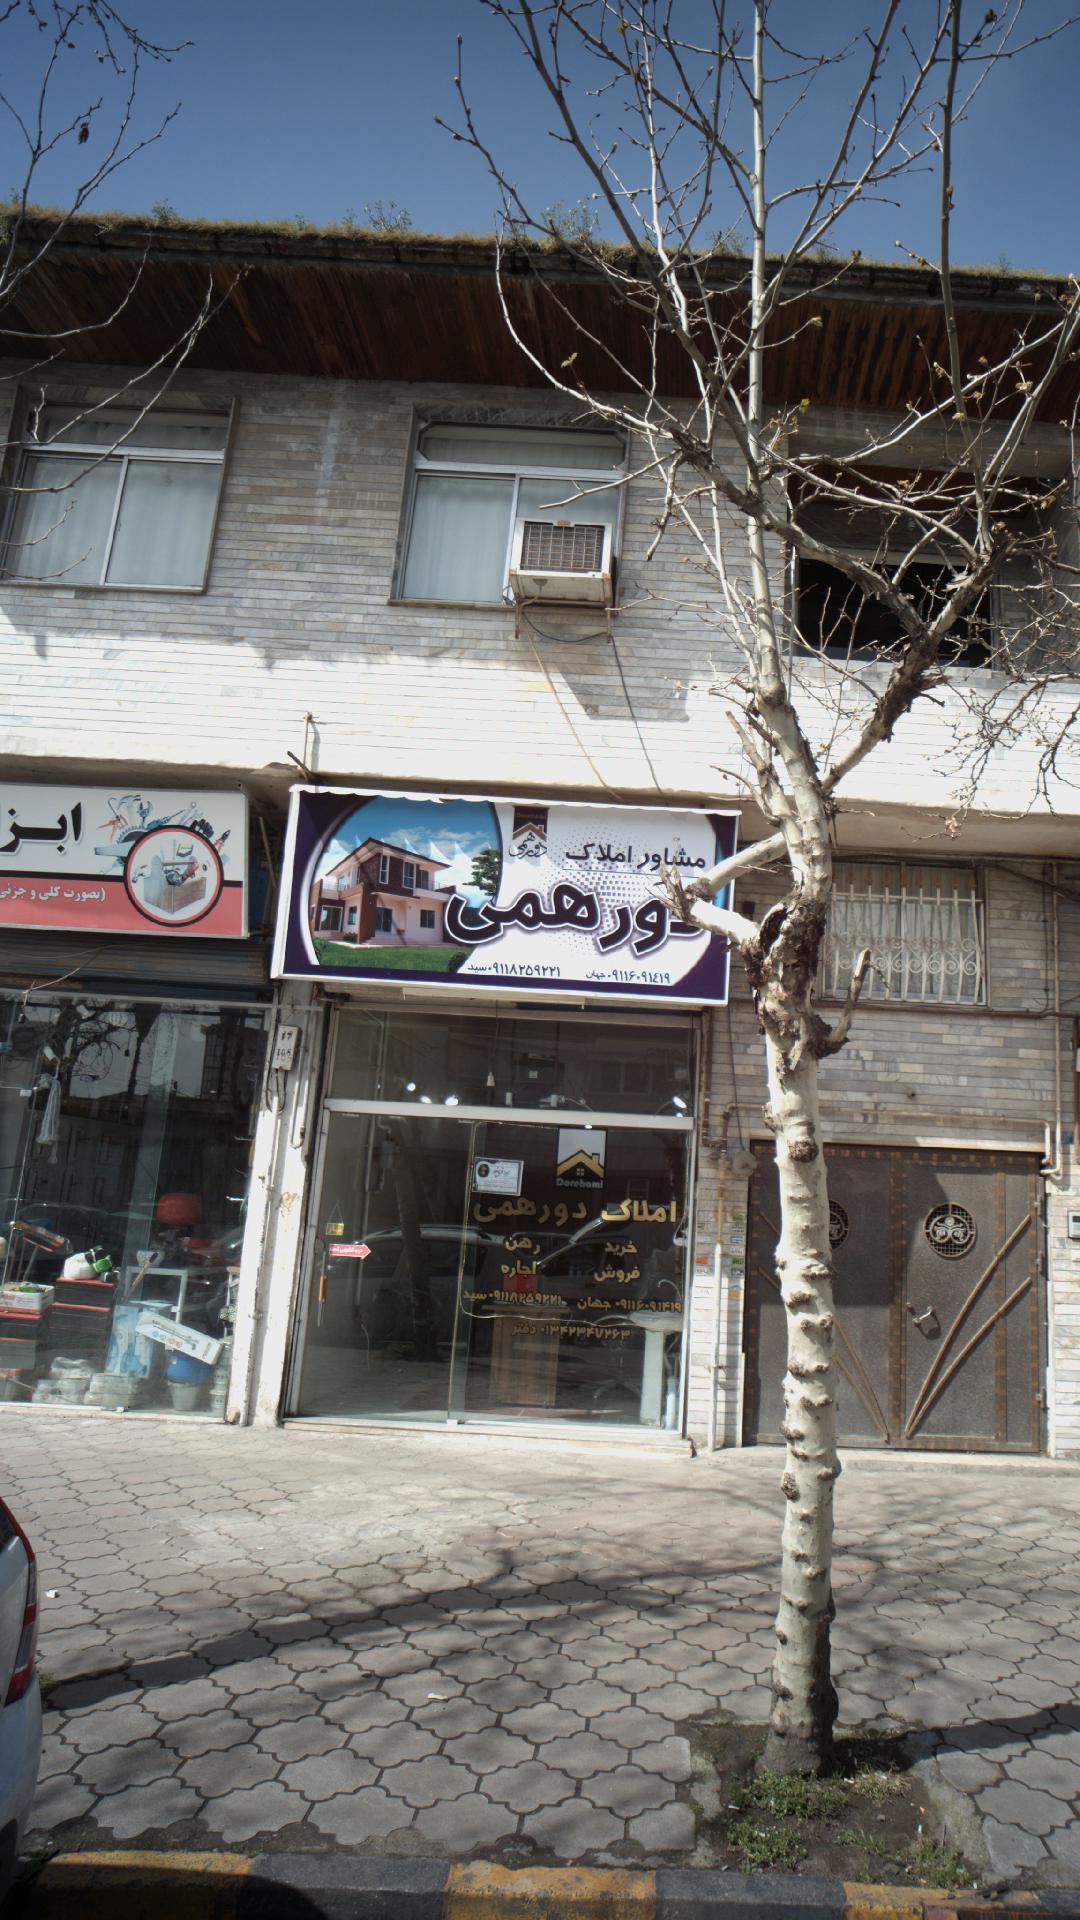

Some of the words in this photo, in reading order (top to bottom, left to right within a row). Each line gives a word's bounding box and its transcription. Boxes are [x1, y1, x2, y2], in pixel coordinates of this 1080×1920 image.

[565, 843, 632, 863] املاک
[637, 847, 706, 872] مشاور
[30, 888, 37, 900] و
[601, 1198, 677, 1223] املاک
[505, 1235, 540, 1255] رهن
[604, 1240, 638, 1256] خرید
[501, 1260, 537, 1279] اجاره
[593, 1265, 641, 1283] فروش
[463, 1290, 488, 1302] سید
[577, 1296, 612, 1312] جهان
[512, 1323, 537, 1336] دفتر
